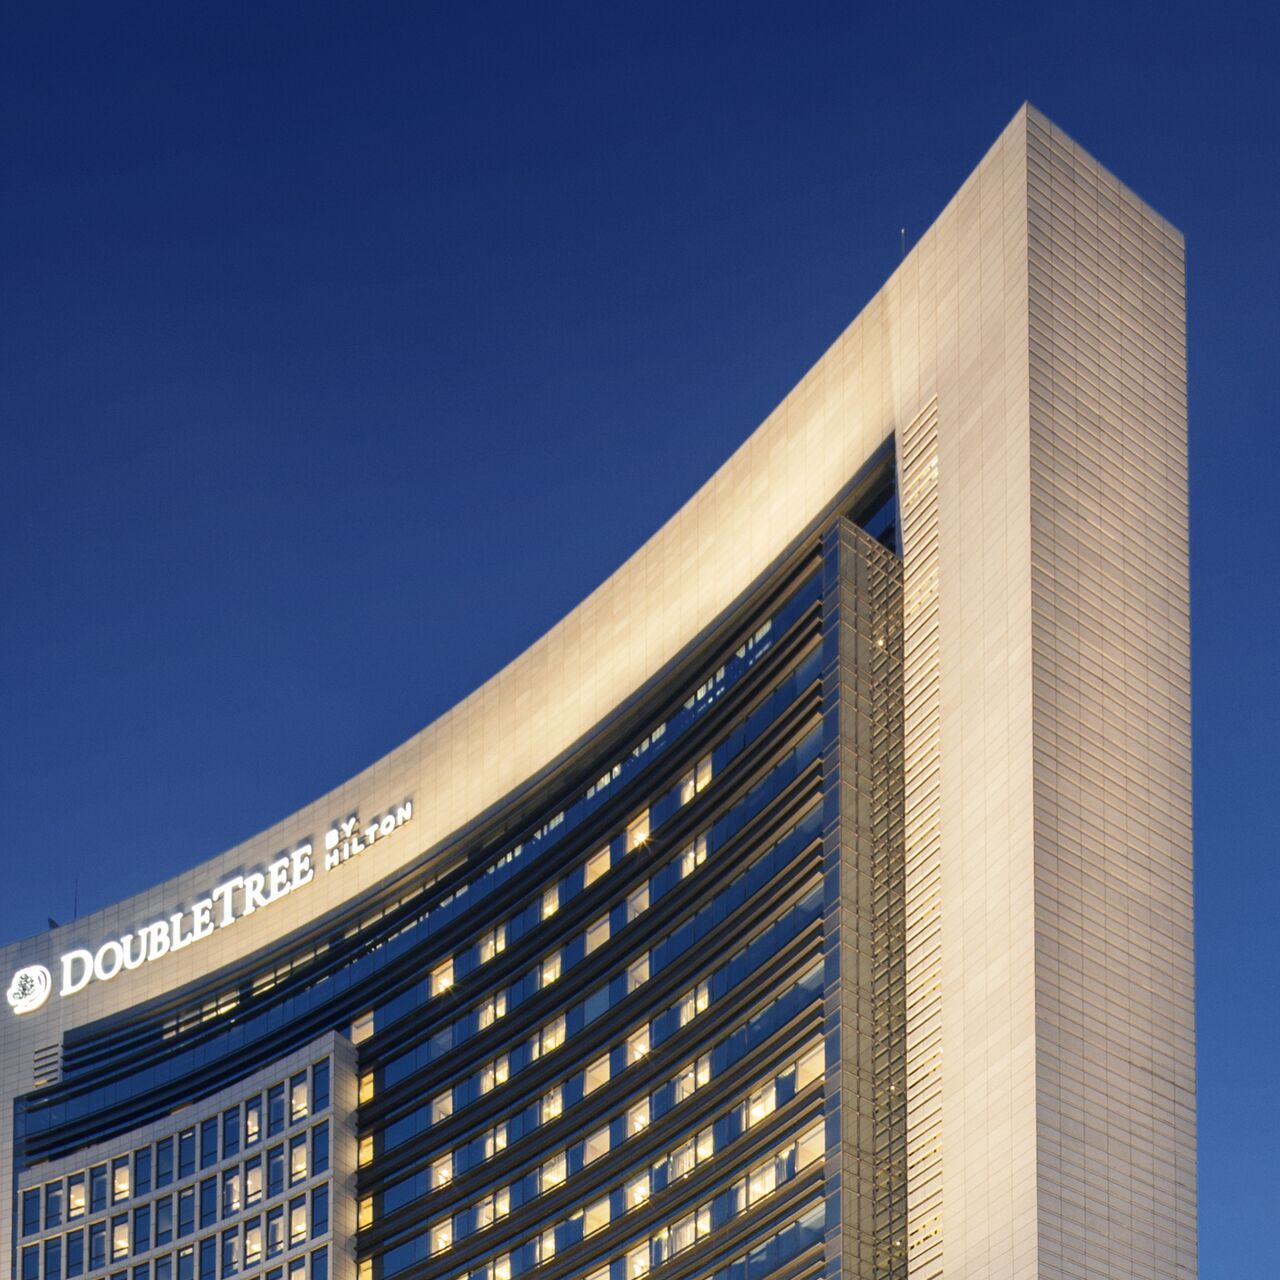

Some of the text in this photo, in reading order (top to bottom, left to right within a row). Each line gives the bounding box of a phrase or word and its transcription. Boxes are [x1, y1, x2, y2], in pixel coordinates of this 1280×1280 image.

[324, 802, 412, 871] HILTON
[325, 817, 357, 850] BY
[60, 844, 314, 997] DOUBLETREE
